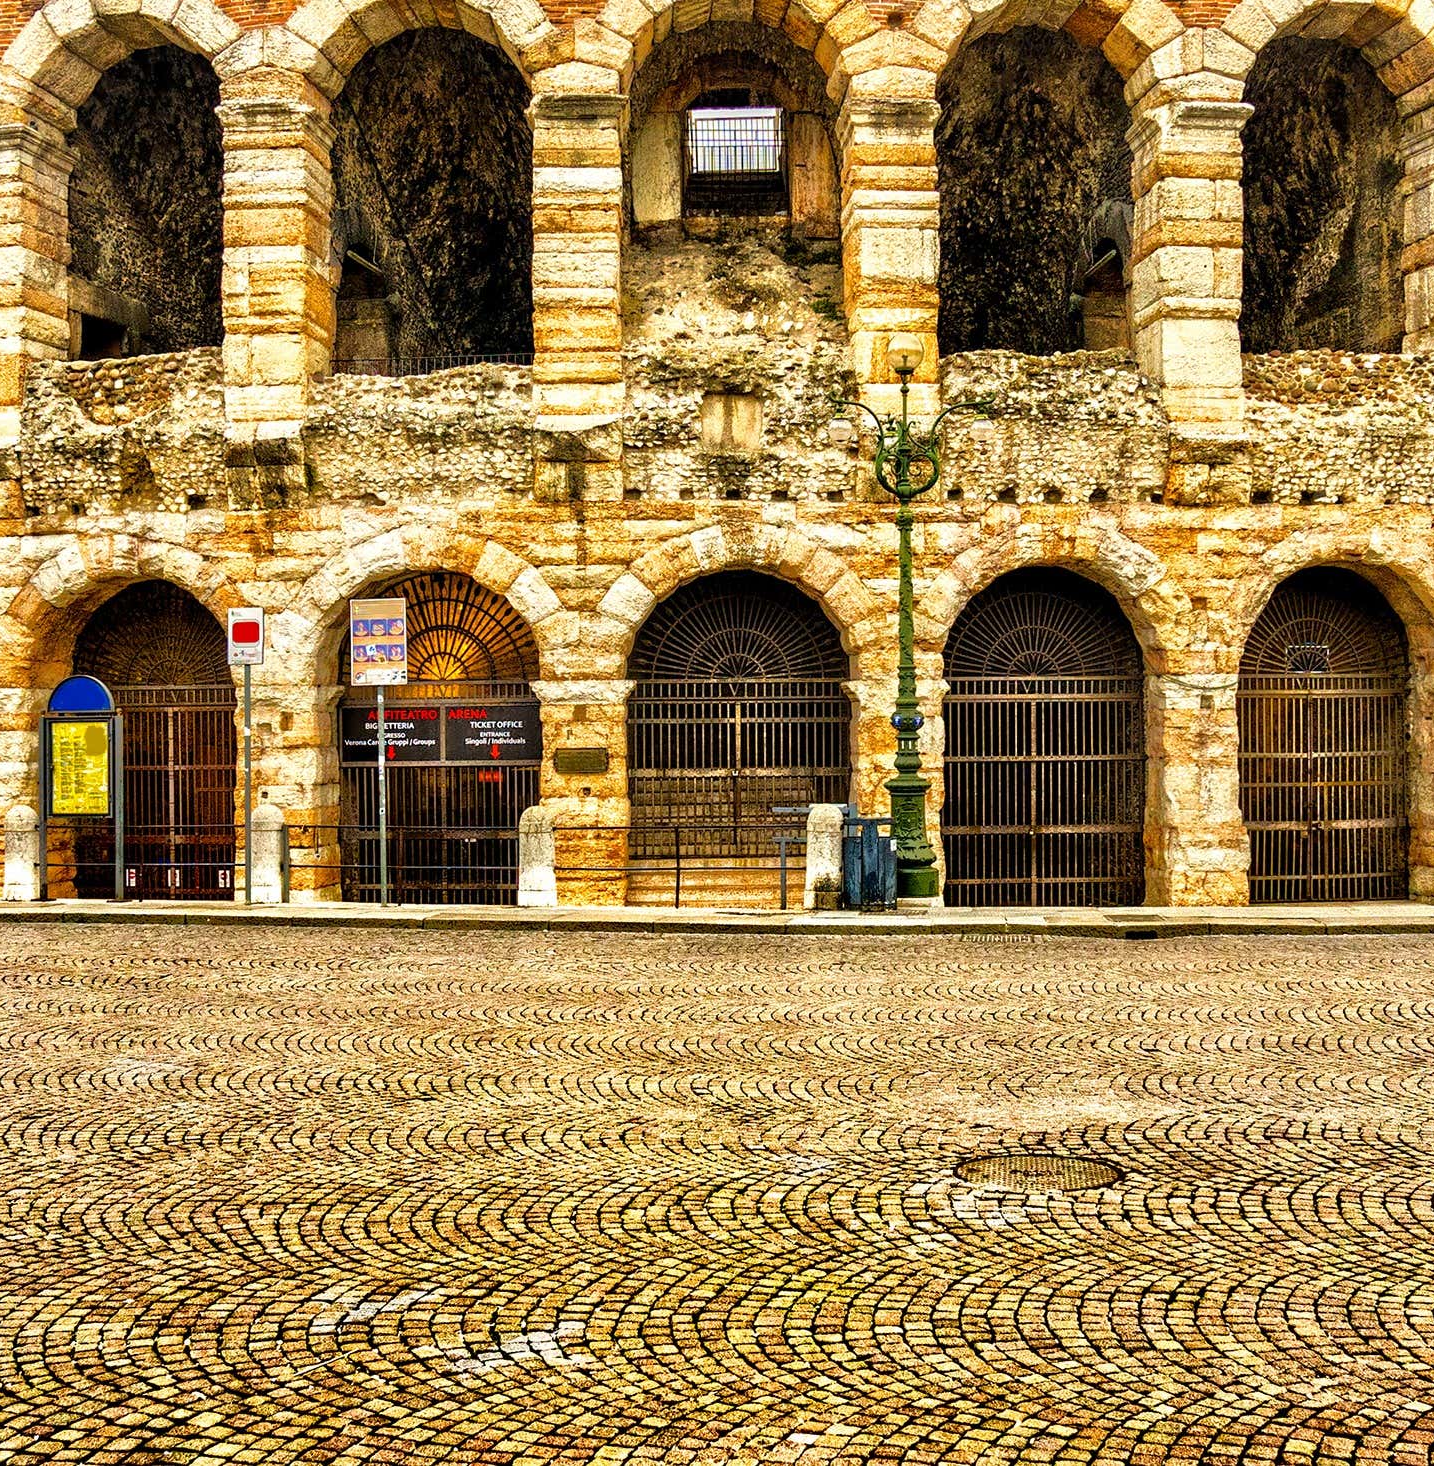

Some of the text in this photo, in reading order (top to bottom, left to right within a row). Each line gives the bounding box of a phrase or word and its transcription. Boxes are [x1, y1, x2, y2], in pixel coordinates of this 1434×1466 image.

[368, 708, 487, 721] AFITEATRO ARENA
[365, 722, 415, 730] BIGETTERIA
[470, 720, 524, 729] TICKET OFFICE
[387, 738, 409, 747] Gruppi
[413, 738, 436, 747] Groups
[491, 737, 526, 745] Individuals
